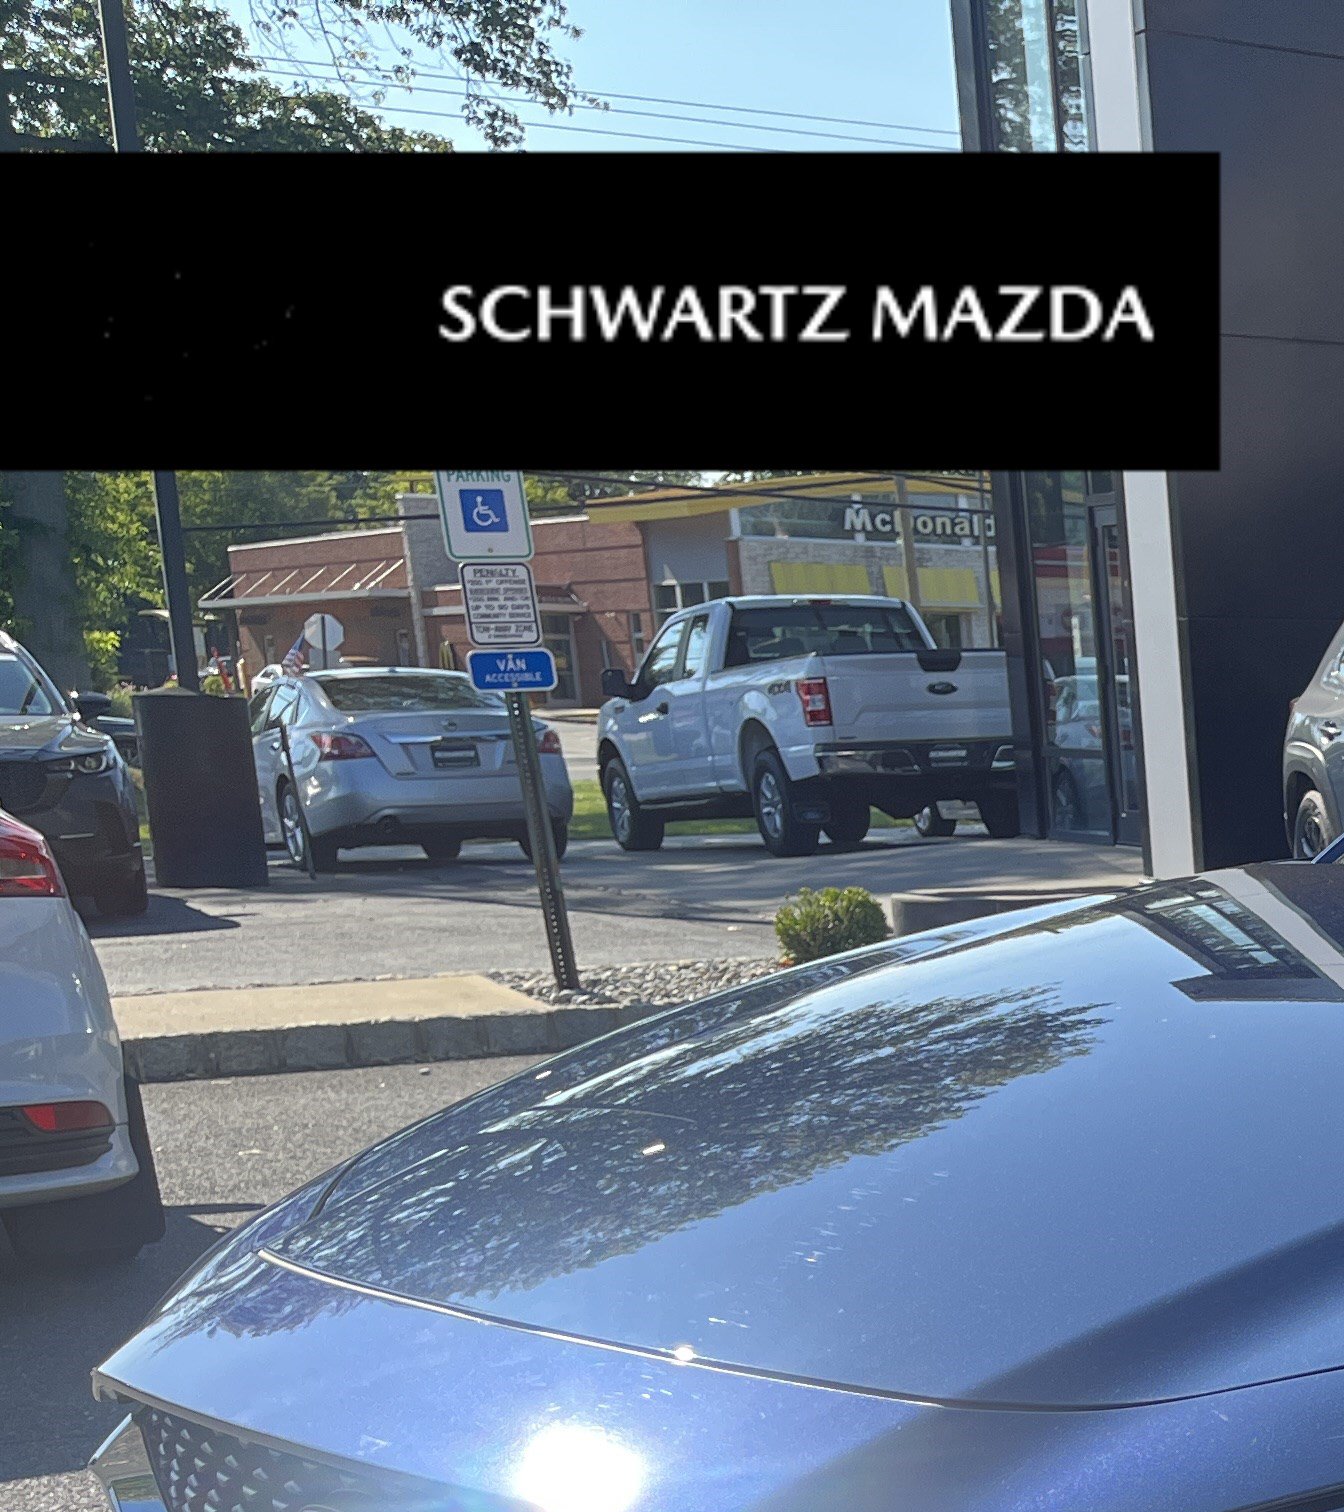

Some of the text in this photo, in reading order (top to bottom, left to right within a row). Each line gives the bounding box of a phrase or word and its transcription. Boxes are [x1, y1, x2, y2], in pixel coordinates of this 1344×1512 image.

[447, 470, 511, 482] PARKING
[496, 658, 527, 671] VAN
[485, 671, 542, 683] ACCESSIBLE
